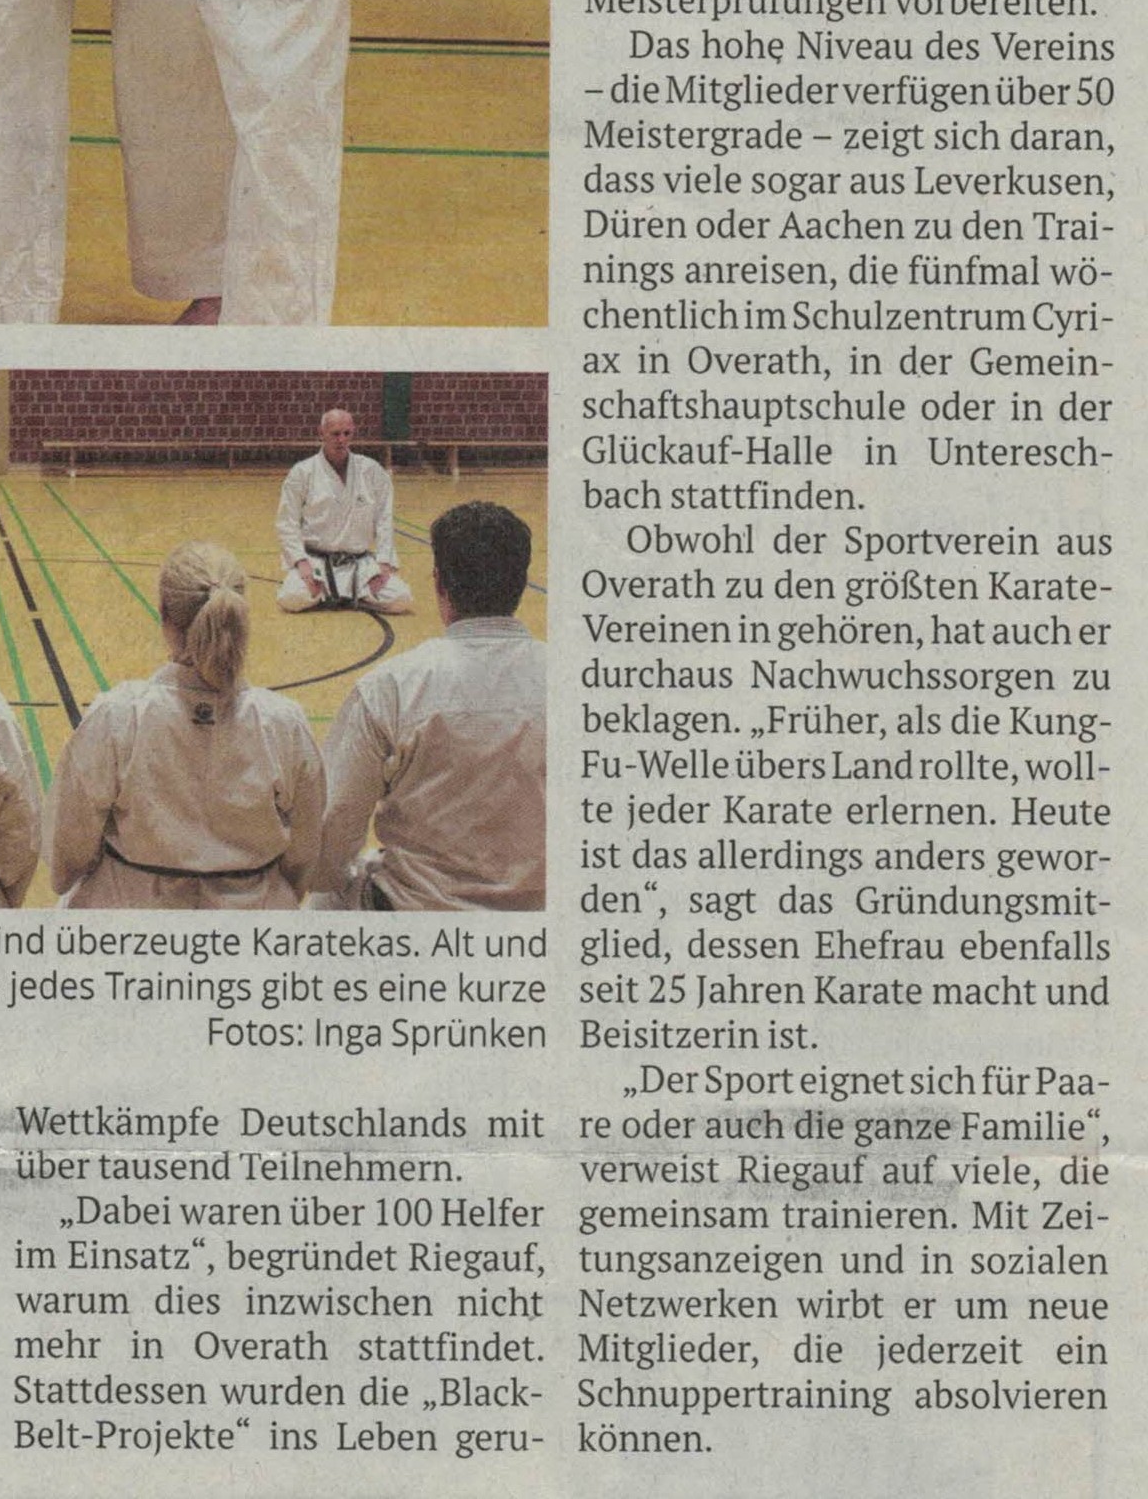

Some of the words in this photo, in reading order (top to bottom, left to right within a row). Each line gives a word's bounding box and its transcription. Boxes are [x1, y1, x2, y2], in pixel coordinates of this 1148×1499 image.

[584, 206, 687, 238] Düren
[696, 208, 771, 239] oder
[779, 209, 905, 240] Aachen
[914, 219, 952, 240] zu
[963, 209, 1024, 240] den
[1033, 211, 1114, 240] Trai-
[581, 658, 733, 689] durchaus
[751, 659, 1055, 698] Nachwuchssorgen
[1073, 669, 1110, 691] zu
[57, 925, 240, 964] überzeugte
[254, 926, 419, 957] Karatekas.
[431, 927, 474, 957] Alt
[486, 927, 546, 958] und
[7, 970, 94, 1008] jedes
[105, 971, 251, 1010] Trainings
[261, 971, 323, 1010] gibt
[334, 979, 368, 1002] es
[379, 973, 447, 1002] eine
[459, 972, 546, 1003] kurze
[209, 1017, 303, 1046] Fotos:
[316, 1018, 381, 1055] Inga
[392, 1017, 545, 1056] Sprünken
[16, 1105, 219, 1143] Wettkämpfe
[241, 1107, 466, 1137] Deutschlands
[488, 1109, 544, 1138] mit
[578, 1288, 778, 1318] Netzwerken
[797, 1288, 884, 1319] wirbt
[904, 1298, 936, 1319] er
[955, 1298, 1008, 1319] um
[1029, 1298, 1108, 1320] neue
[15, 1329, 101, 1359] mehr
[132, 1330, 164, 1359] in
[195, 1330, 328, 1360] Overath
[359, 1331, 543, 1362] stattfindet.
